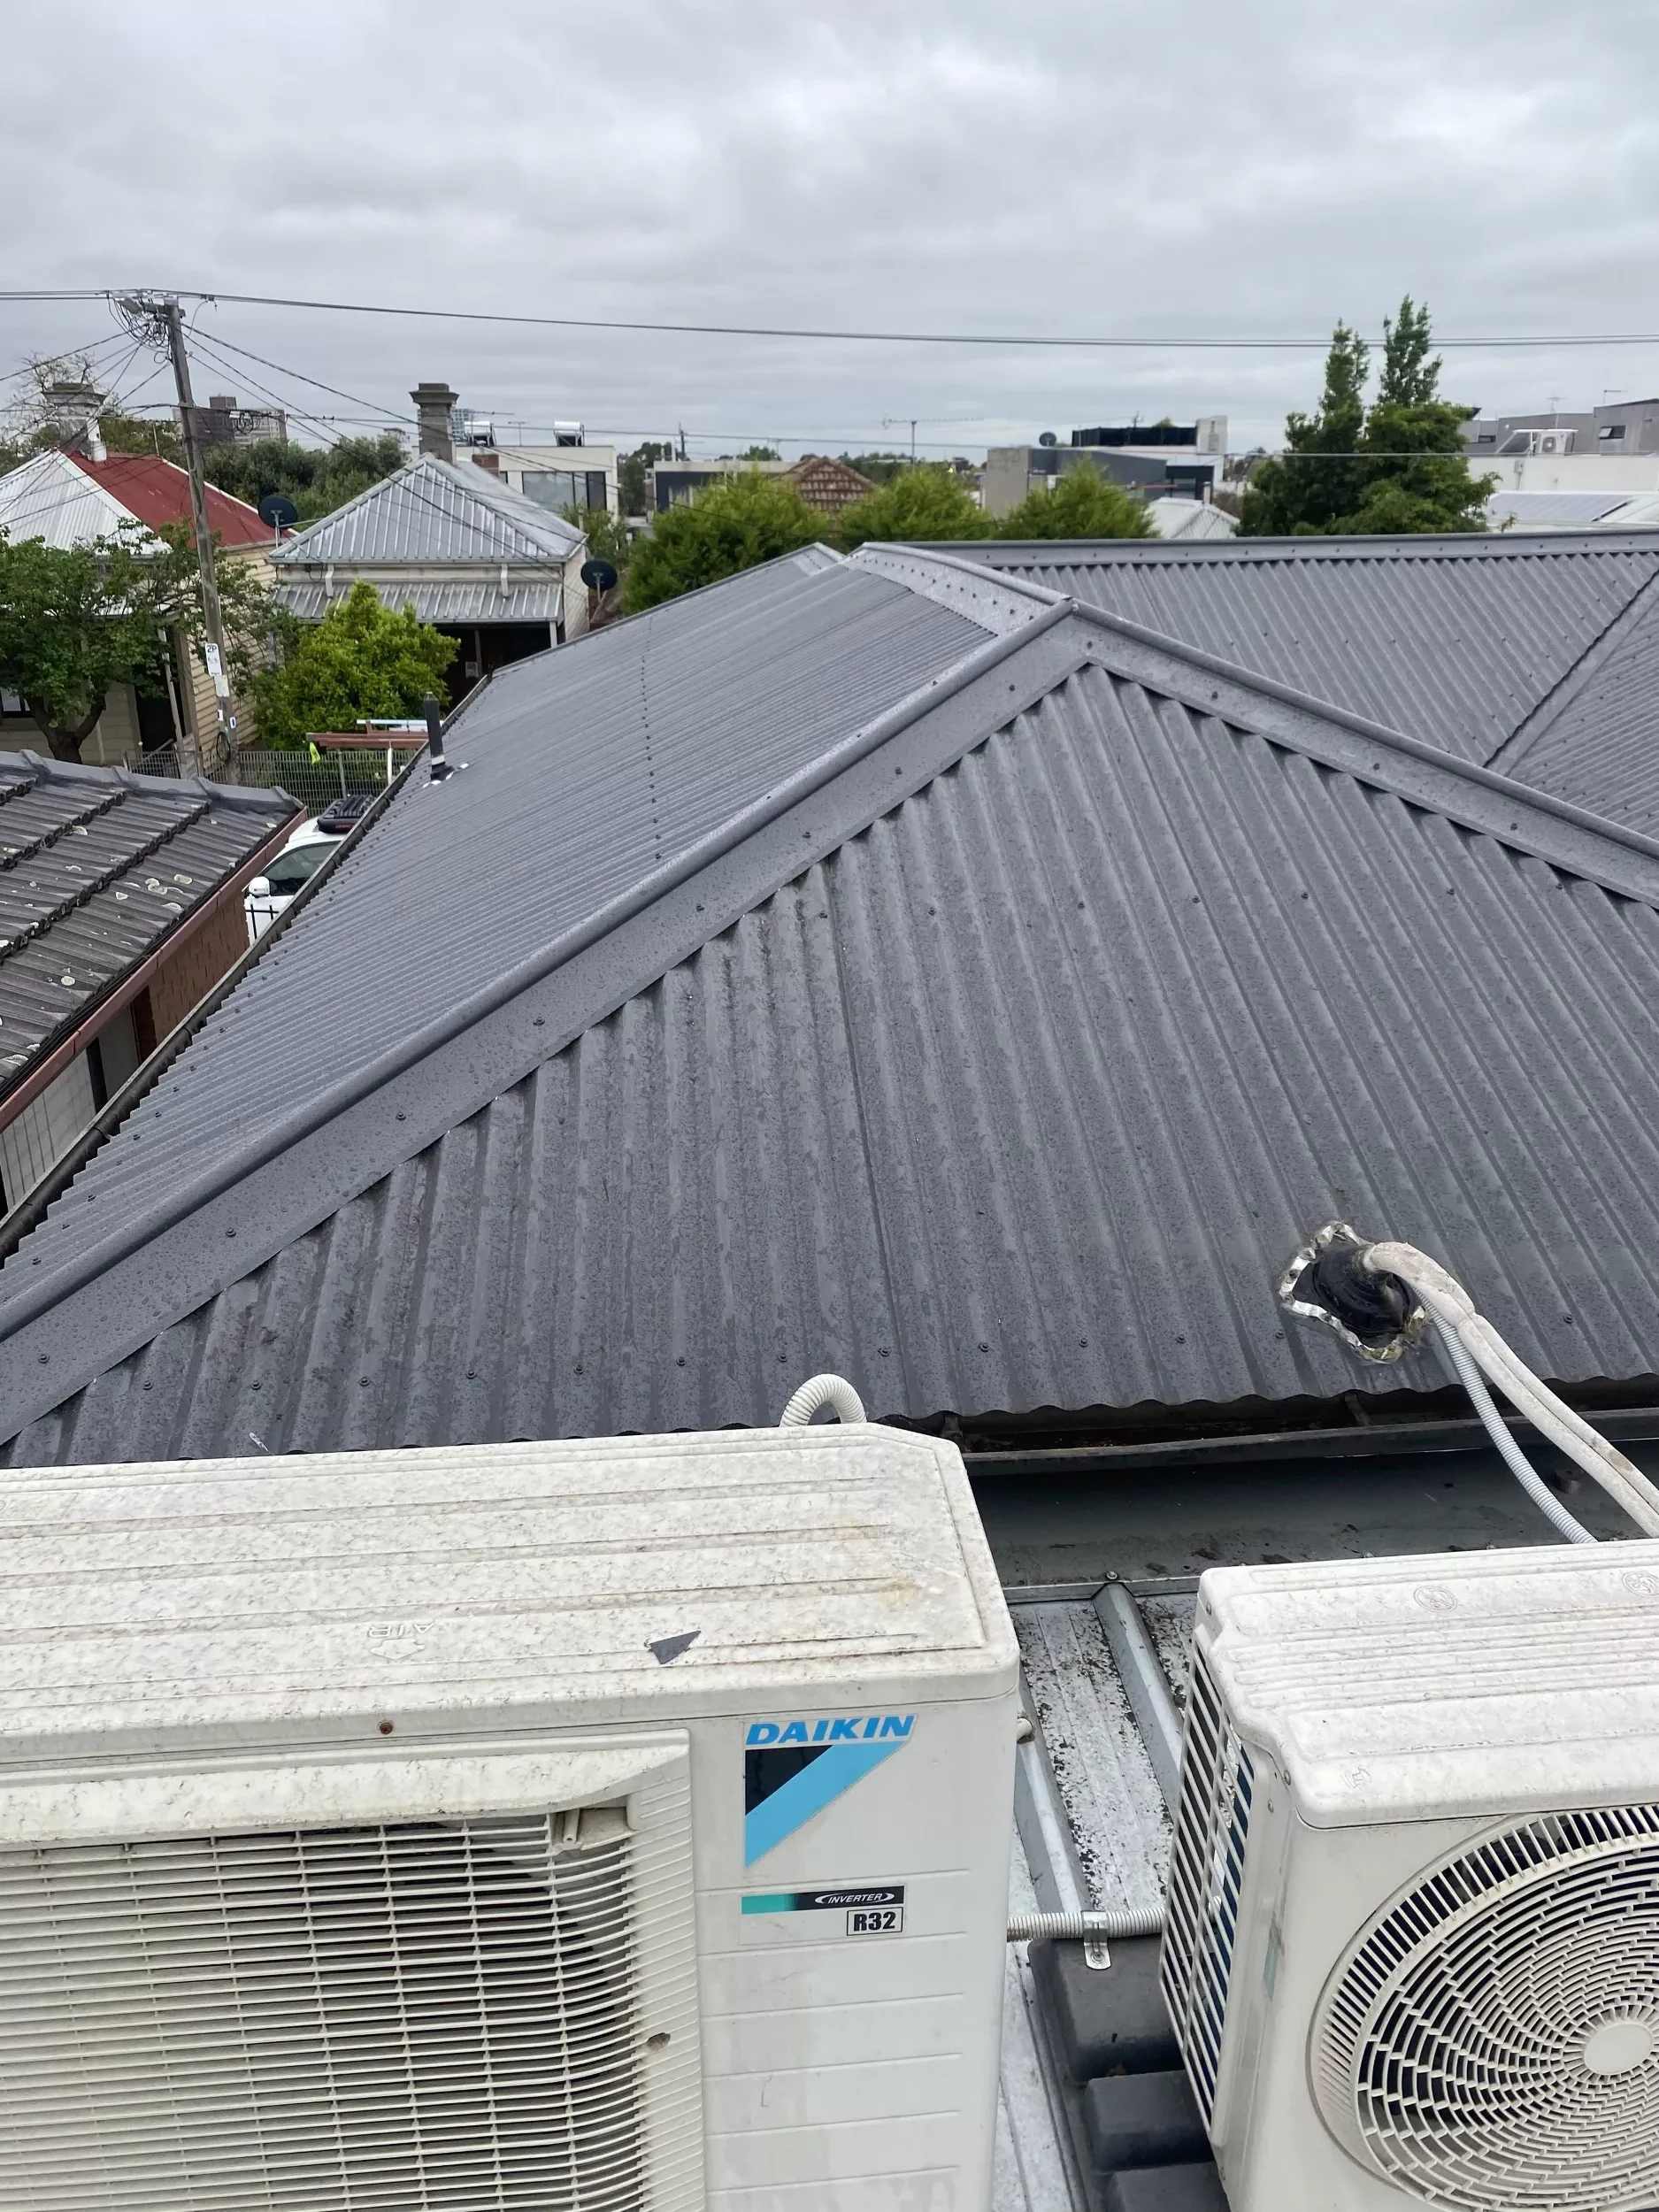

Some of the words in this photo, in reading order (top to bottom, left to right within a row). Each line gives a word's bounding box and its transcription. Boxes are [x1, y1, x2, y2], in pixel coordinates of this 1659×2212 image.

[745, 1714, 915, 1746] DAIKIN
[827, 1893, 883, 1904] INVERTER
[853, 1911, 896, 1932] R32
